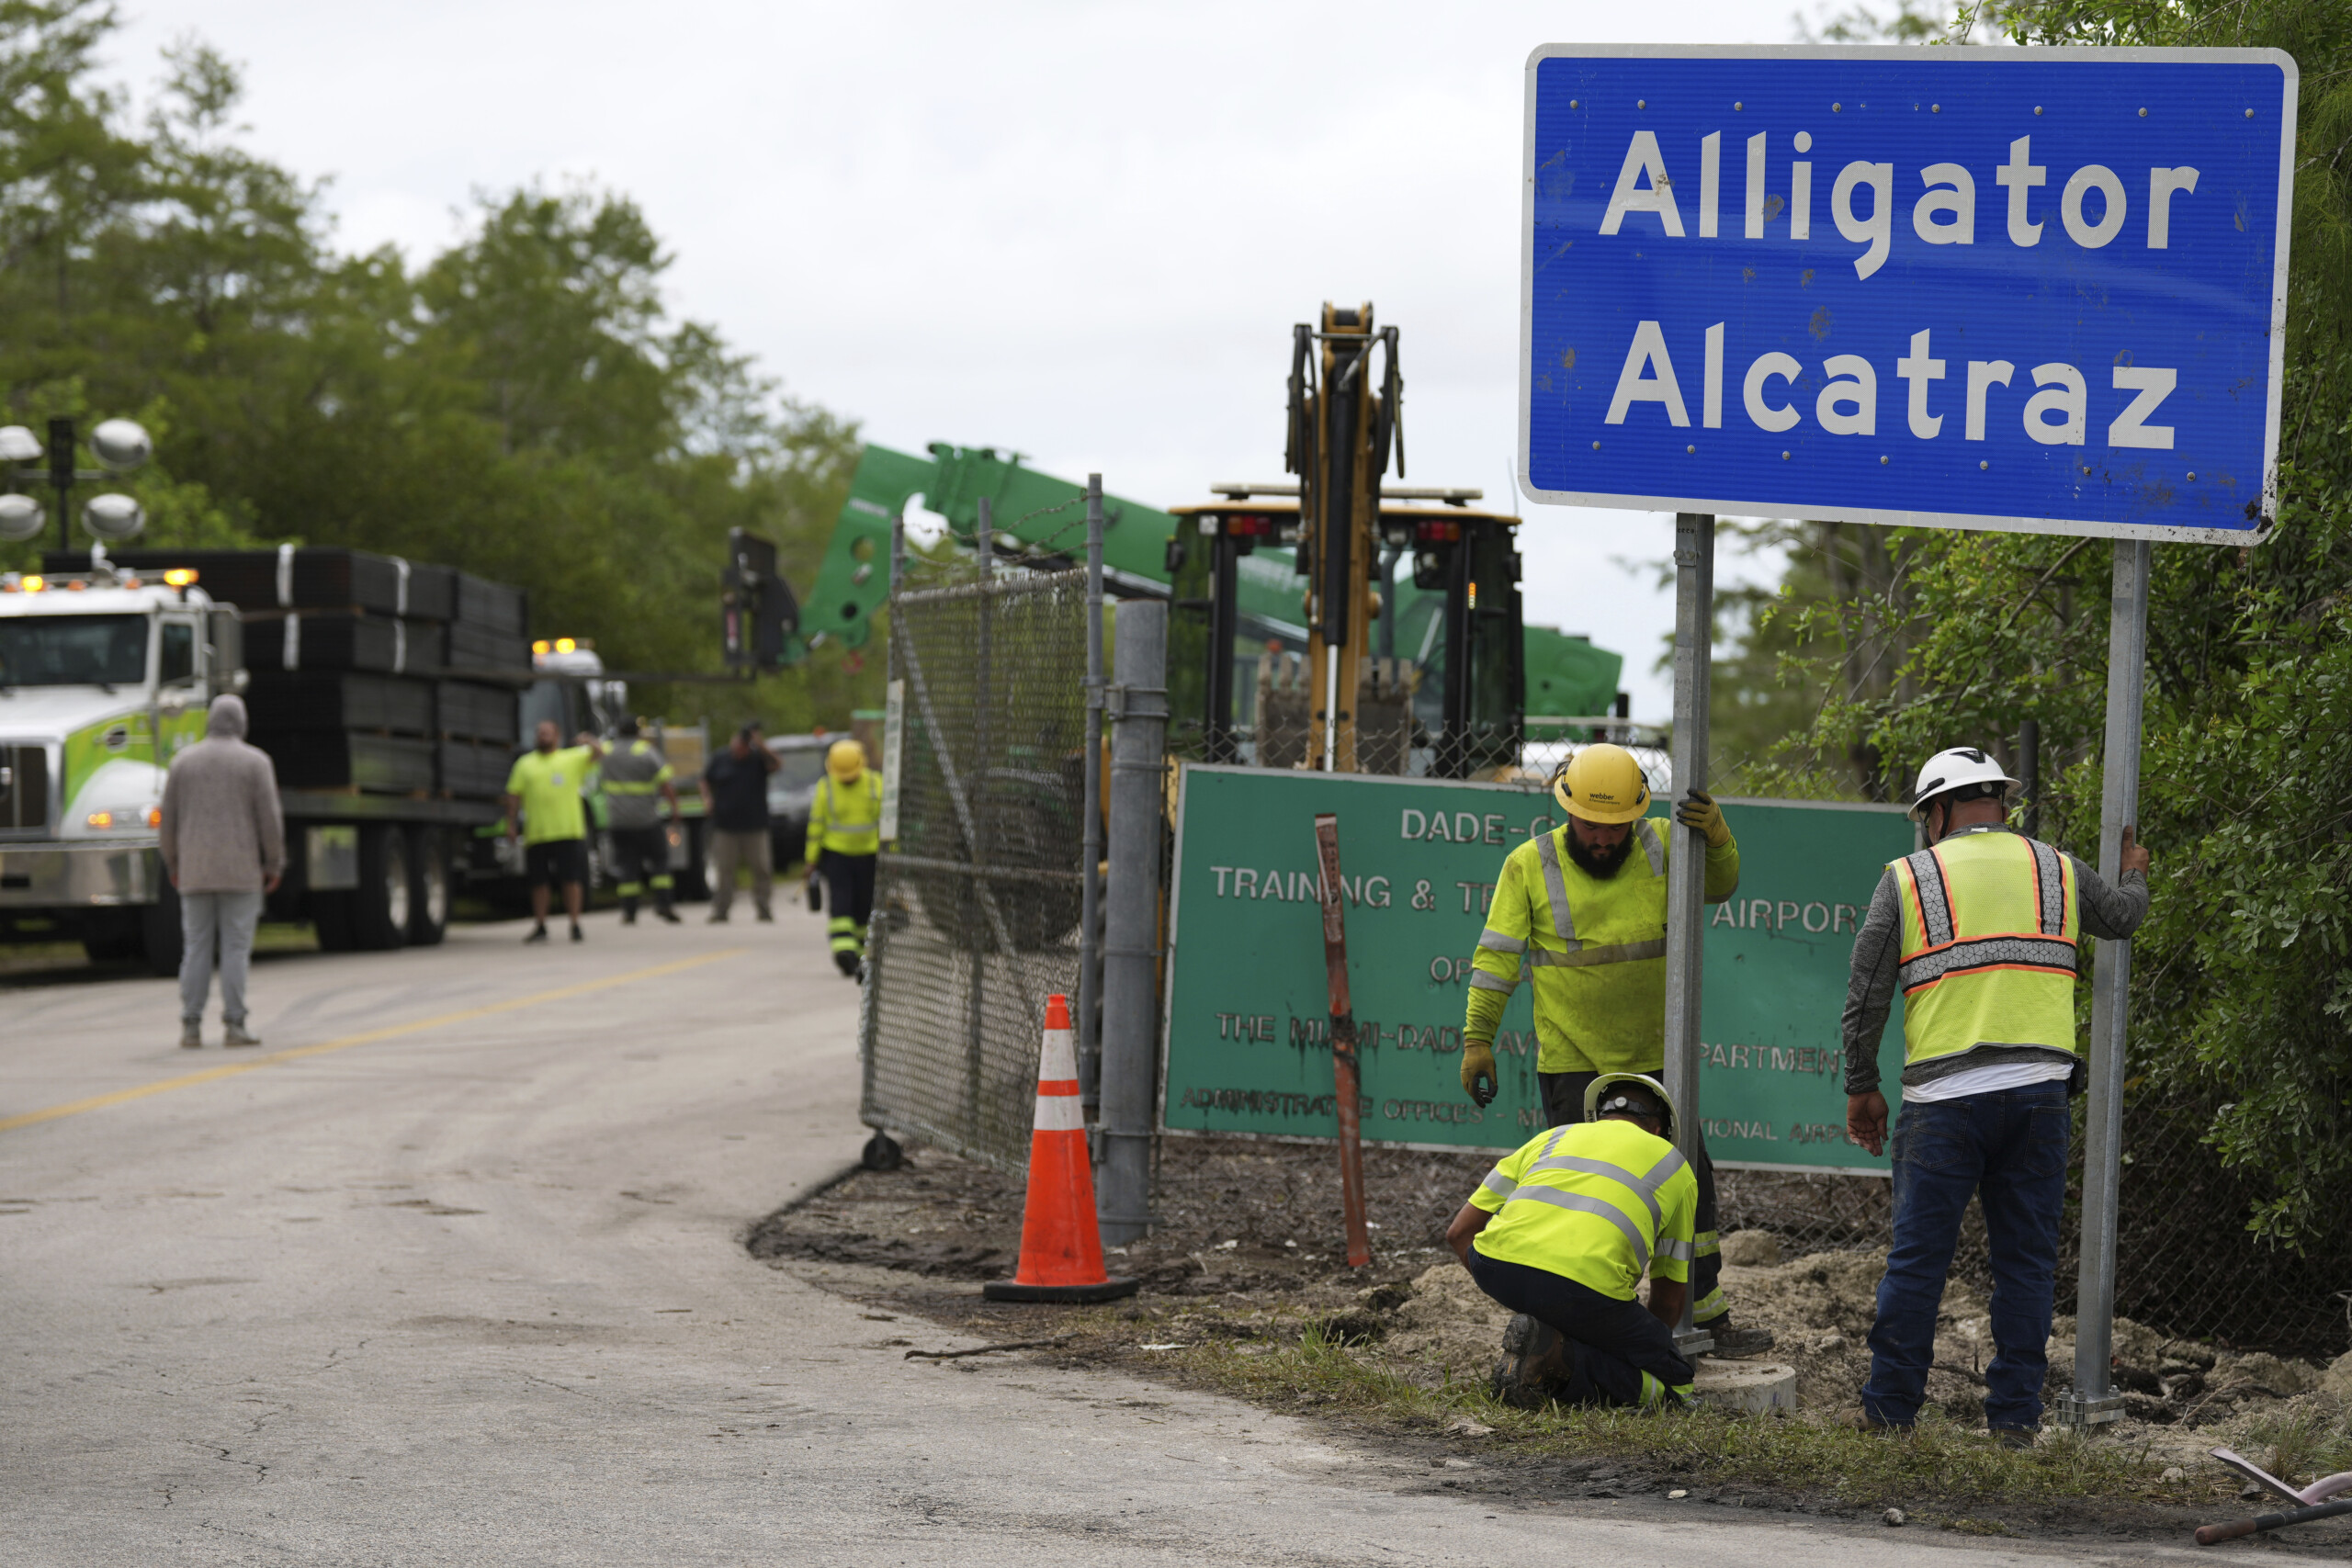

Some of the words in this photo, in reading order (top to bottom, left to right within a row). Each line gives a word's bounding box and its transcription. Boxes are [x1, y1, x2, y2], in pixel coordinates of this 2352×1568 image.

[1599, 130, 2200, 281] Alligator
[1604, 320, 2177, 450] Alcatraz
[1401, 808, 1557, 845] DADE-C
[1210, 865, 1392, 909] TRAINNG
[1411, 879, 1436, 911] &
[1712, 898, 1870, 934] AIRPOR
[1216, 1013, 1276, 1043] THE
[1181, 1088, 1374, 1118] ADMINISTRATE
[1384, 1099, 1484, 1124] OFFICES
